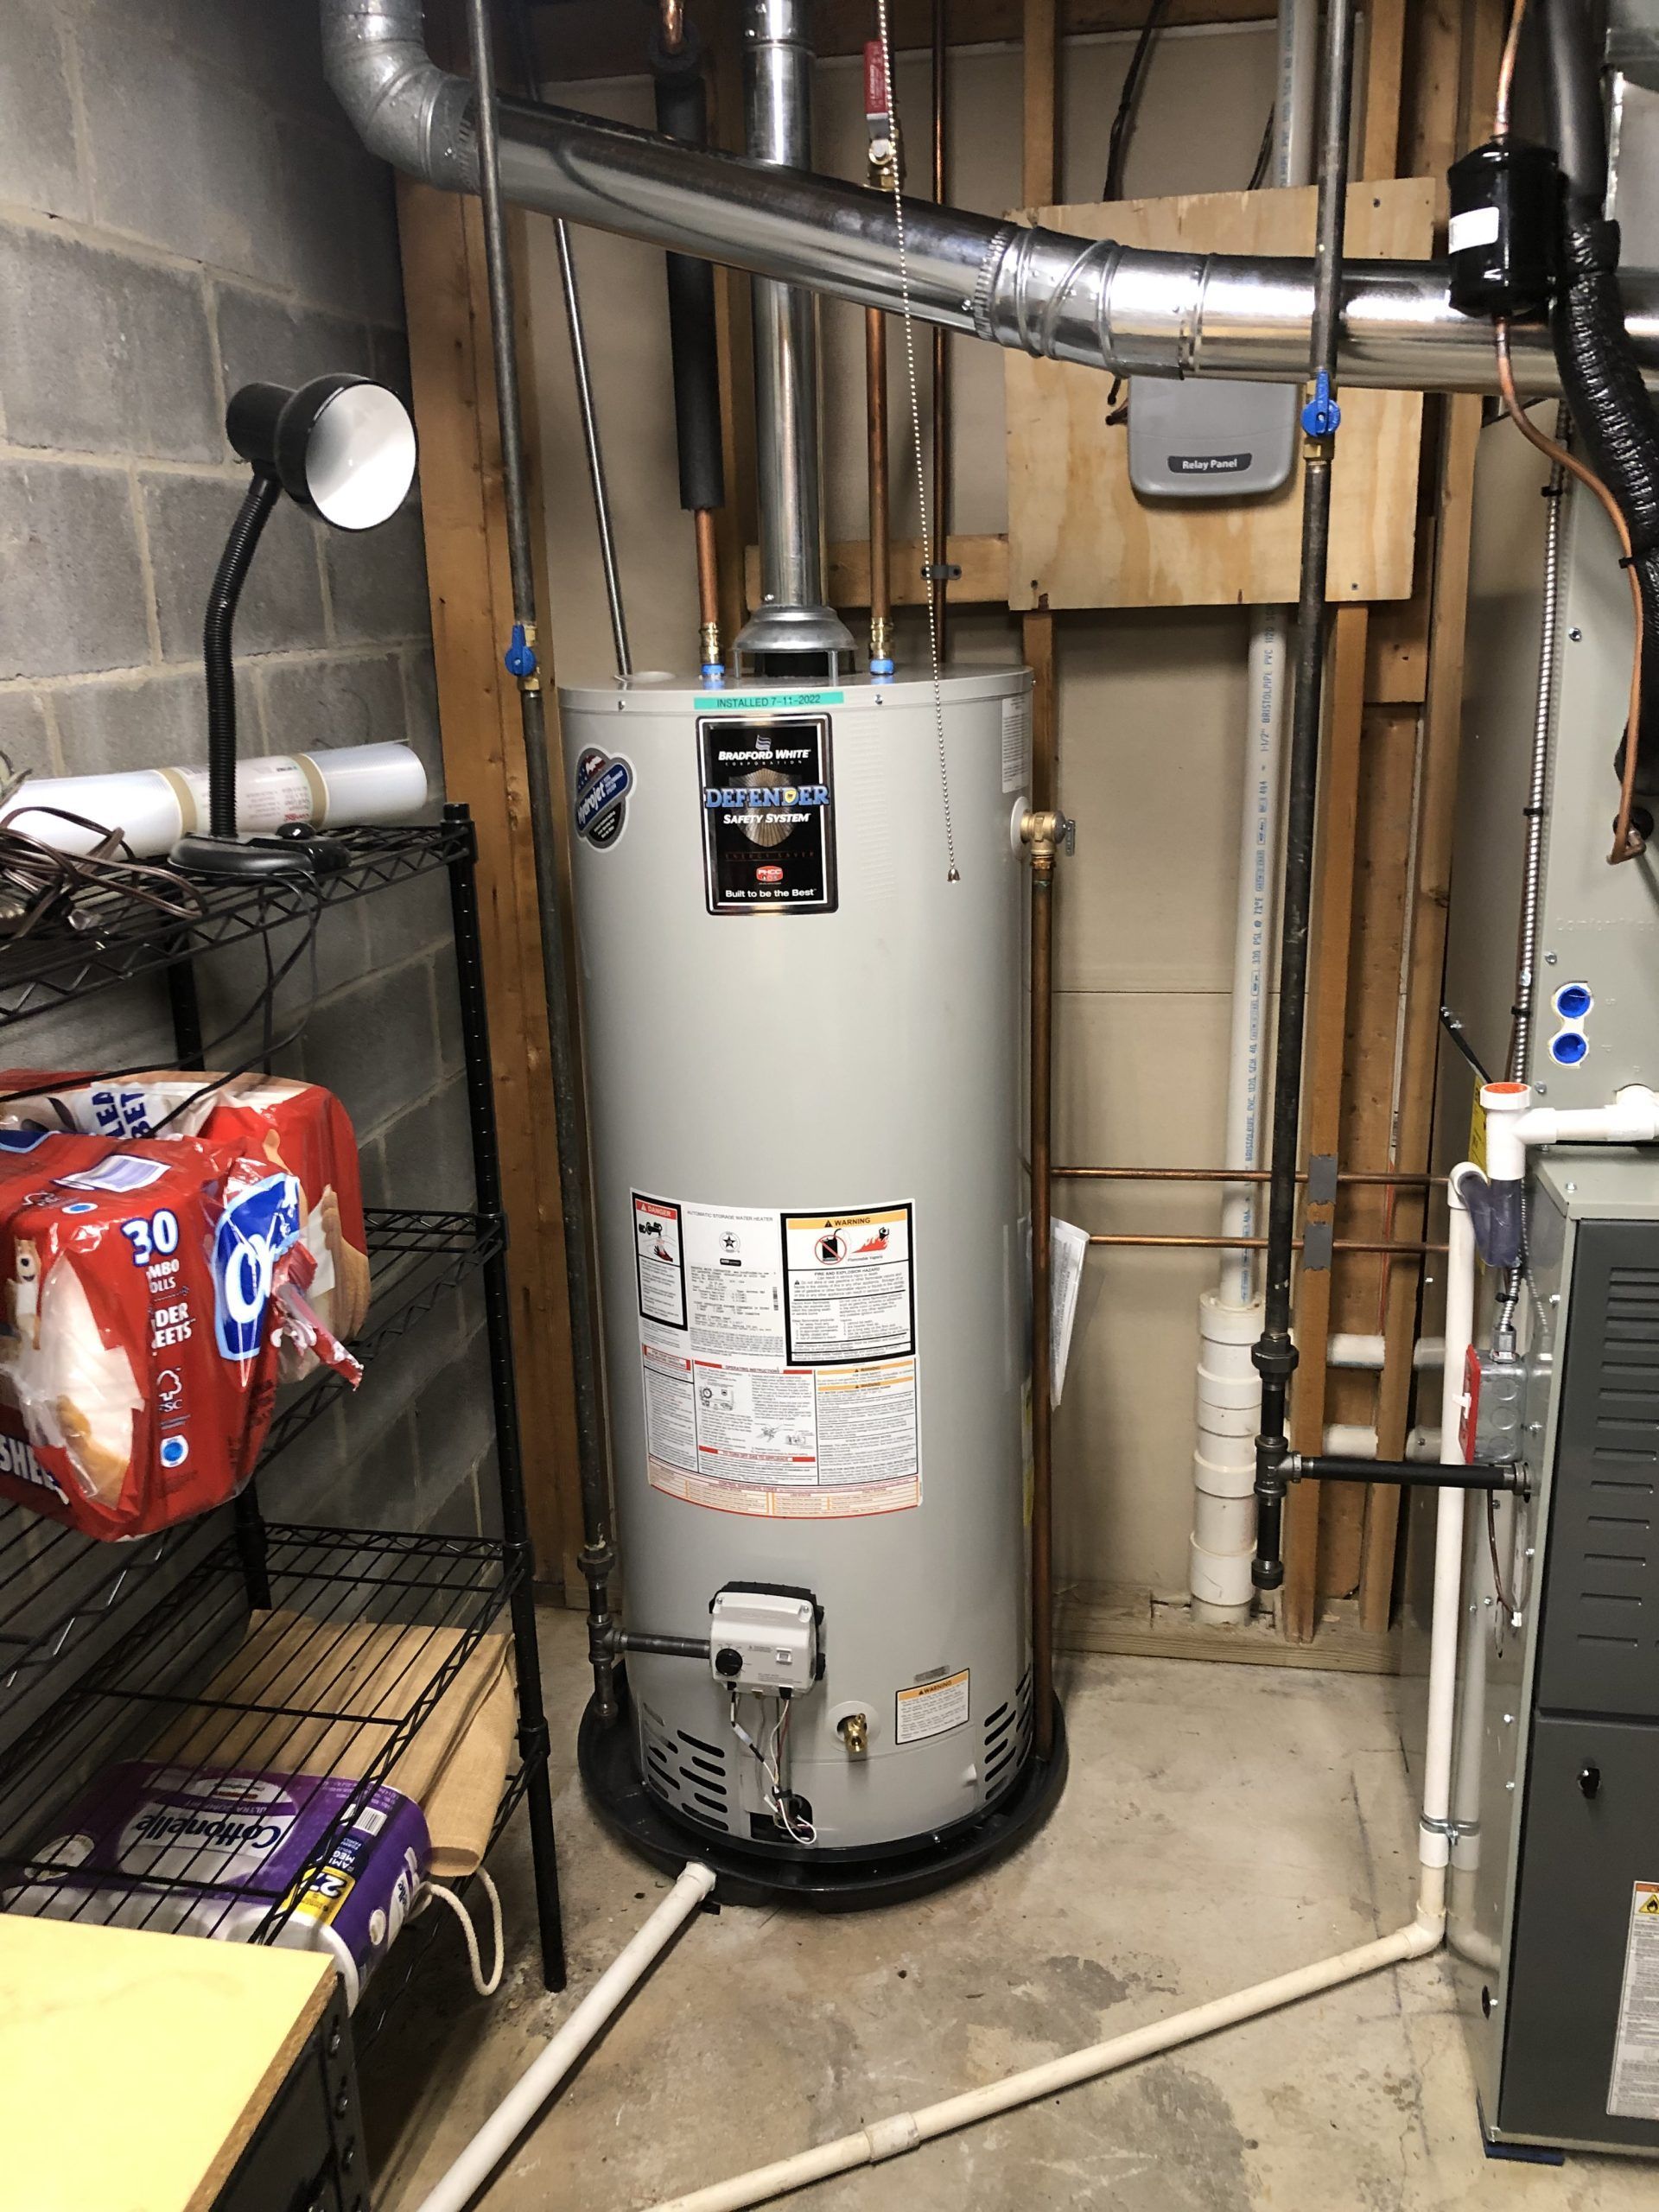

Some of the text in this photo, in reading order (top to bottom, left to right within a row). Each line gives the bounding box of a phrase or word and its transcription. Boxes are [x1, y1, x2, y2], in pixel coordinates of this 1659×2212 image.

[1182, 459, 1237, 471] Relay Panel
[1264, 649, 1273, 665] PVC
[717, 694, 821, 708] INSTALLED 7-11-2022
[718, 749, 810, 760] BRADFORD WHITE
[705, 785, 830, 809] DEFENDER
[723, 813, 810, 824] SAFETY SYSTEM
[760, 889, 772, 898] be
[792, 888, 815, 897] Best
[647, 1205, 671, 1217] DANGER
[835, 1217, 871, 1226] WARNING
[120, 1208, 180, 1268] 30
[146, 1258, 180, 1279] MBO
[149, 1276, 176, 1294] OLLS
[151, 1302, 189, 1332] DER
[151, 1321, 192, 1350] EETS
[136, 1815, 281, 1849] Cottonelle
[332, 1850, 356, 1864] MEG
[328, 1858, 355, 1872] FAMI
